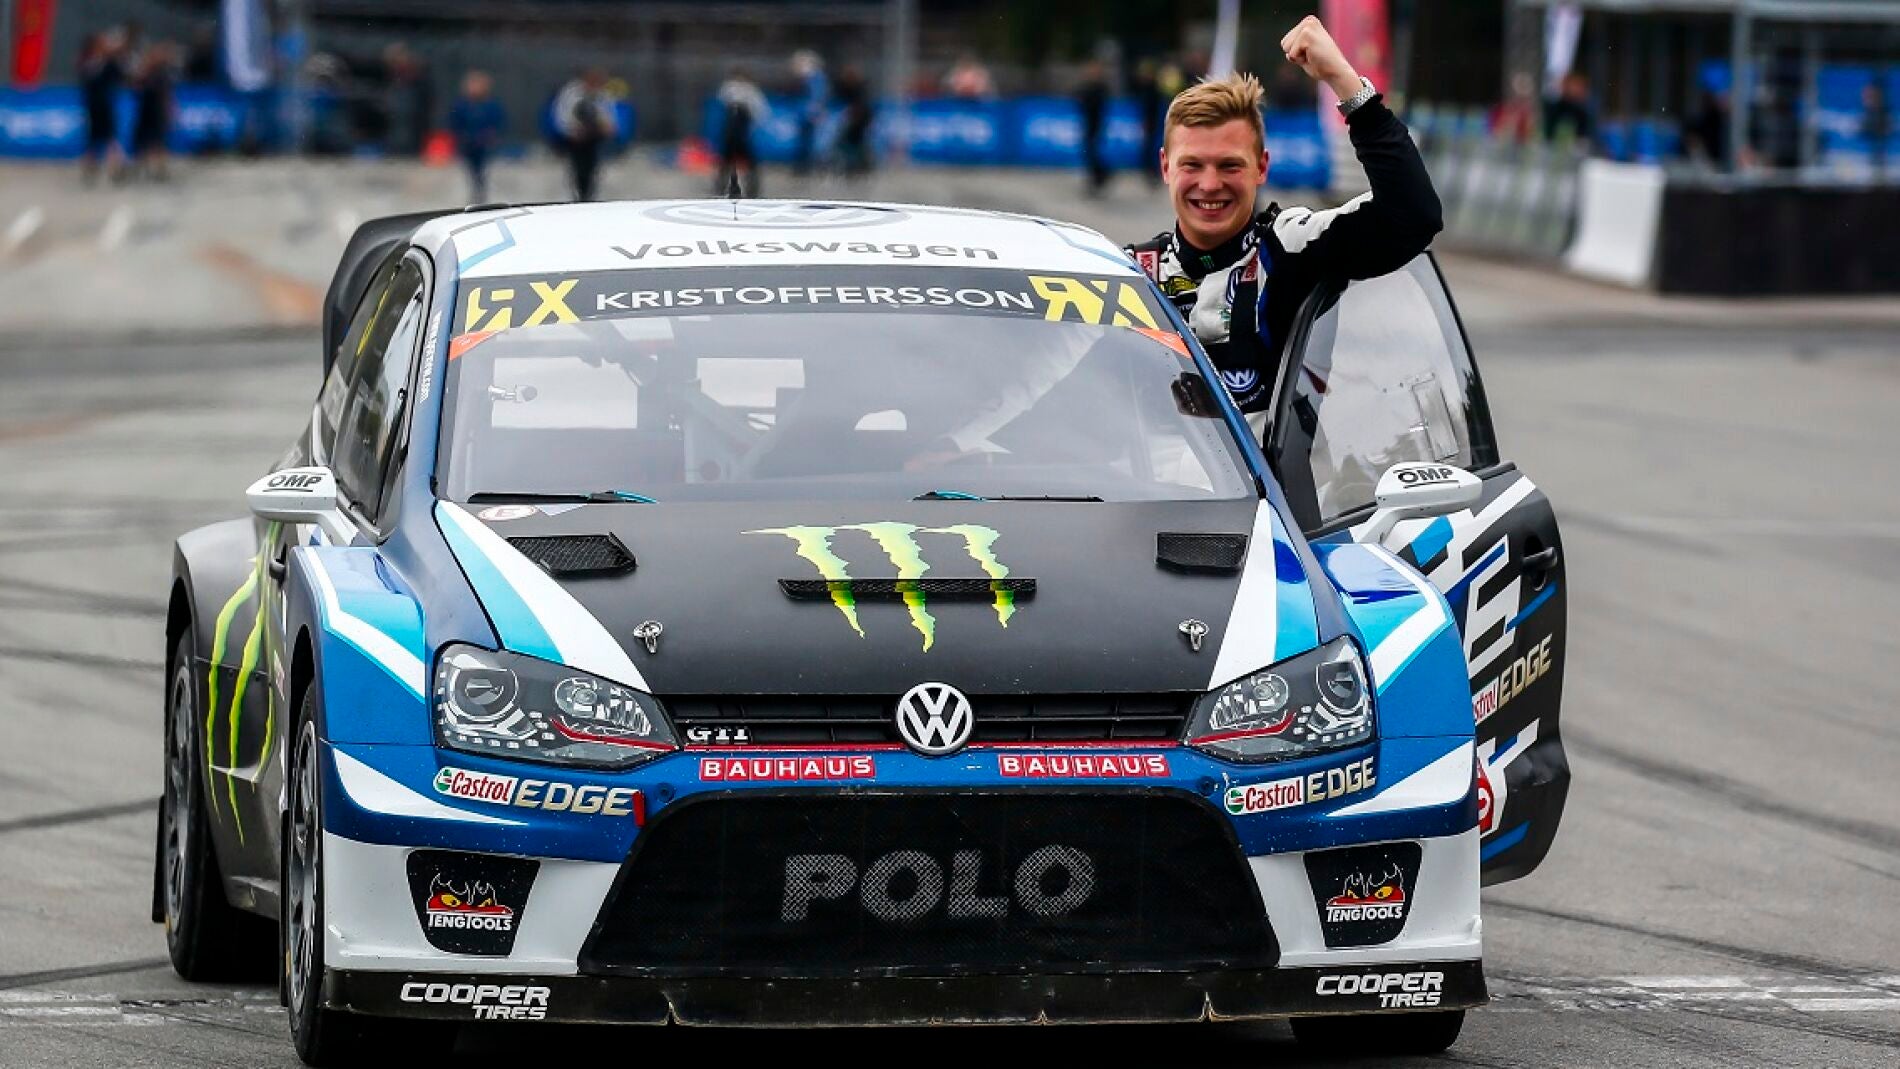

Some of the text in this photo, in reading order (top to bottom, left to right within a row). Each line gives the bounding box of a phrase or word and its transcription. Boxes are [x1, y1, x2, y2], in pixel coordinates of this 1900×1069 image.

[610, 239, 999, 261] Volkswagen
[596, 285, 1034, 311] KRISTOFFERSSON
[267, 474, 322, 488] OMP
[1397, 467, 1454, 483] OMP
[1499, 632, 1553, 709] EDGE
[702, 756, 873, 779] BAUHAUS
[1001, 755, 1166, 777] BAUHAUS
[450, 770, 635, 816] Castrol EDGE
[1244, 755, 1377, 811] Castrol EDGE
[780, 844, 1096, 923] POLO
[400, 981, 551, 1006] COOPER
[1315, 971, 1445, 995] COOPER
[1378, 991, 1442, 1008] TIRES
[471, 1004, 548, 1020] TIRES
